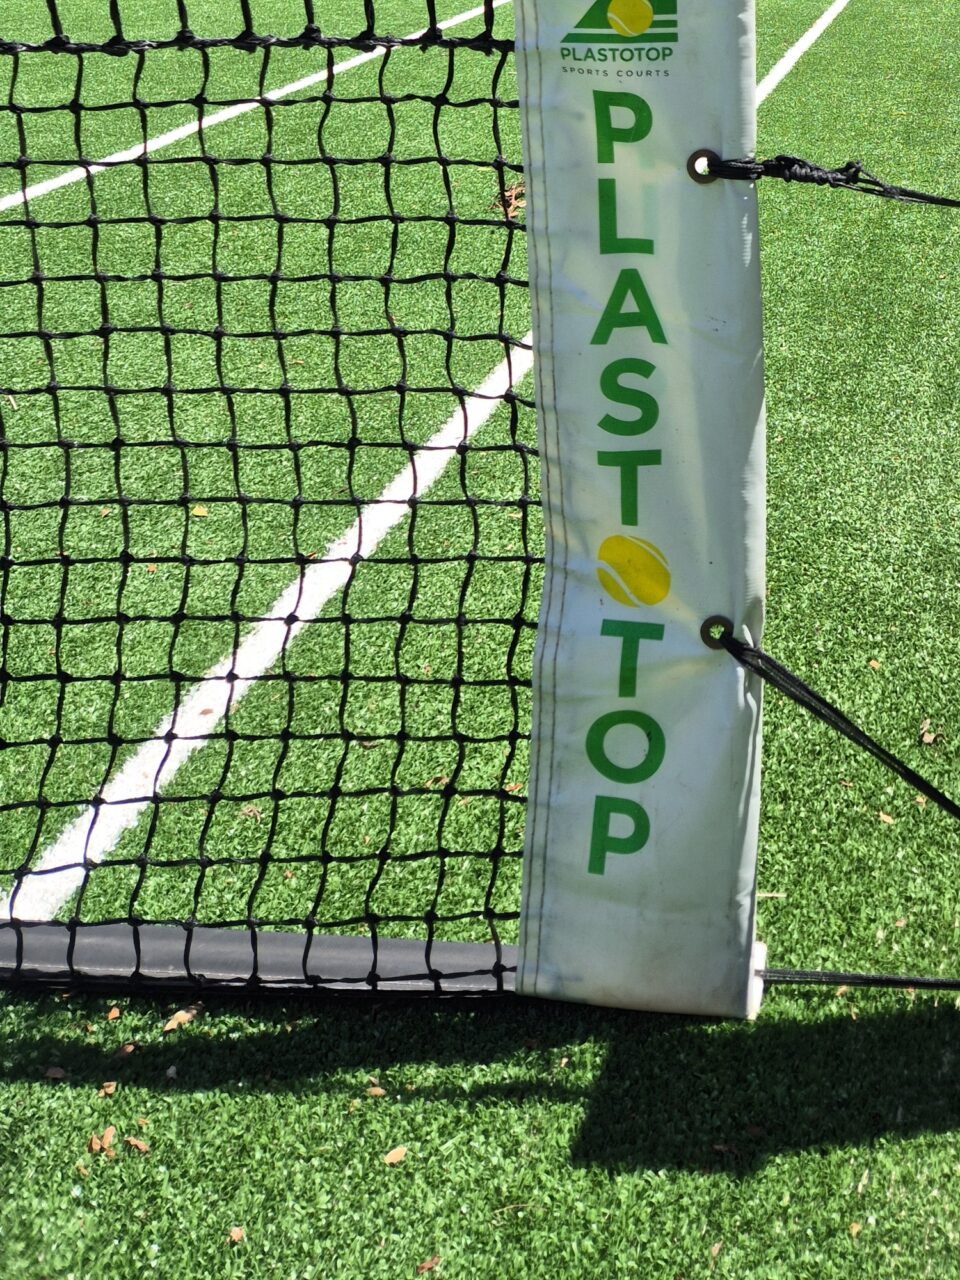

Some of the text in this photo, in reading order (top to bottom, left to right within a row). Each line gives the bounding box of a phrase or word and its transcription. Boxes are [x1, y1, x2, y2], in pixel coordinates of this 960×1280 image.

[560, 46, 673, 63] PLASTOTOP
[561, 66, 671, 78] SPORTS COURTS
